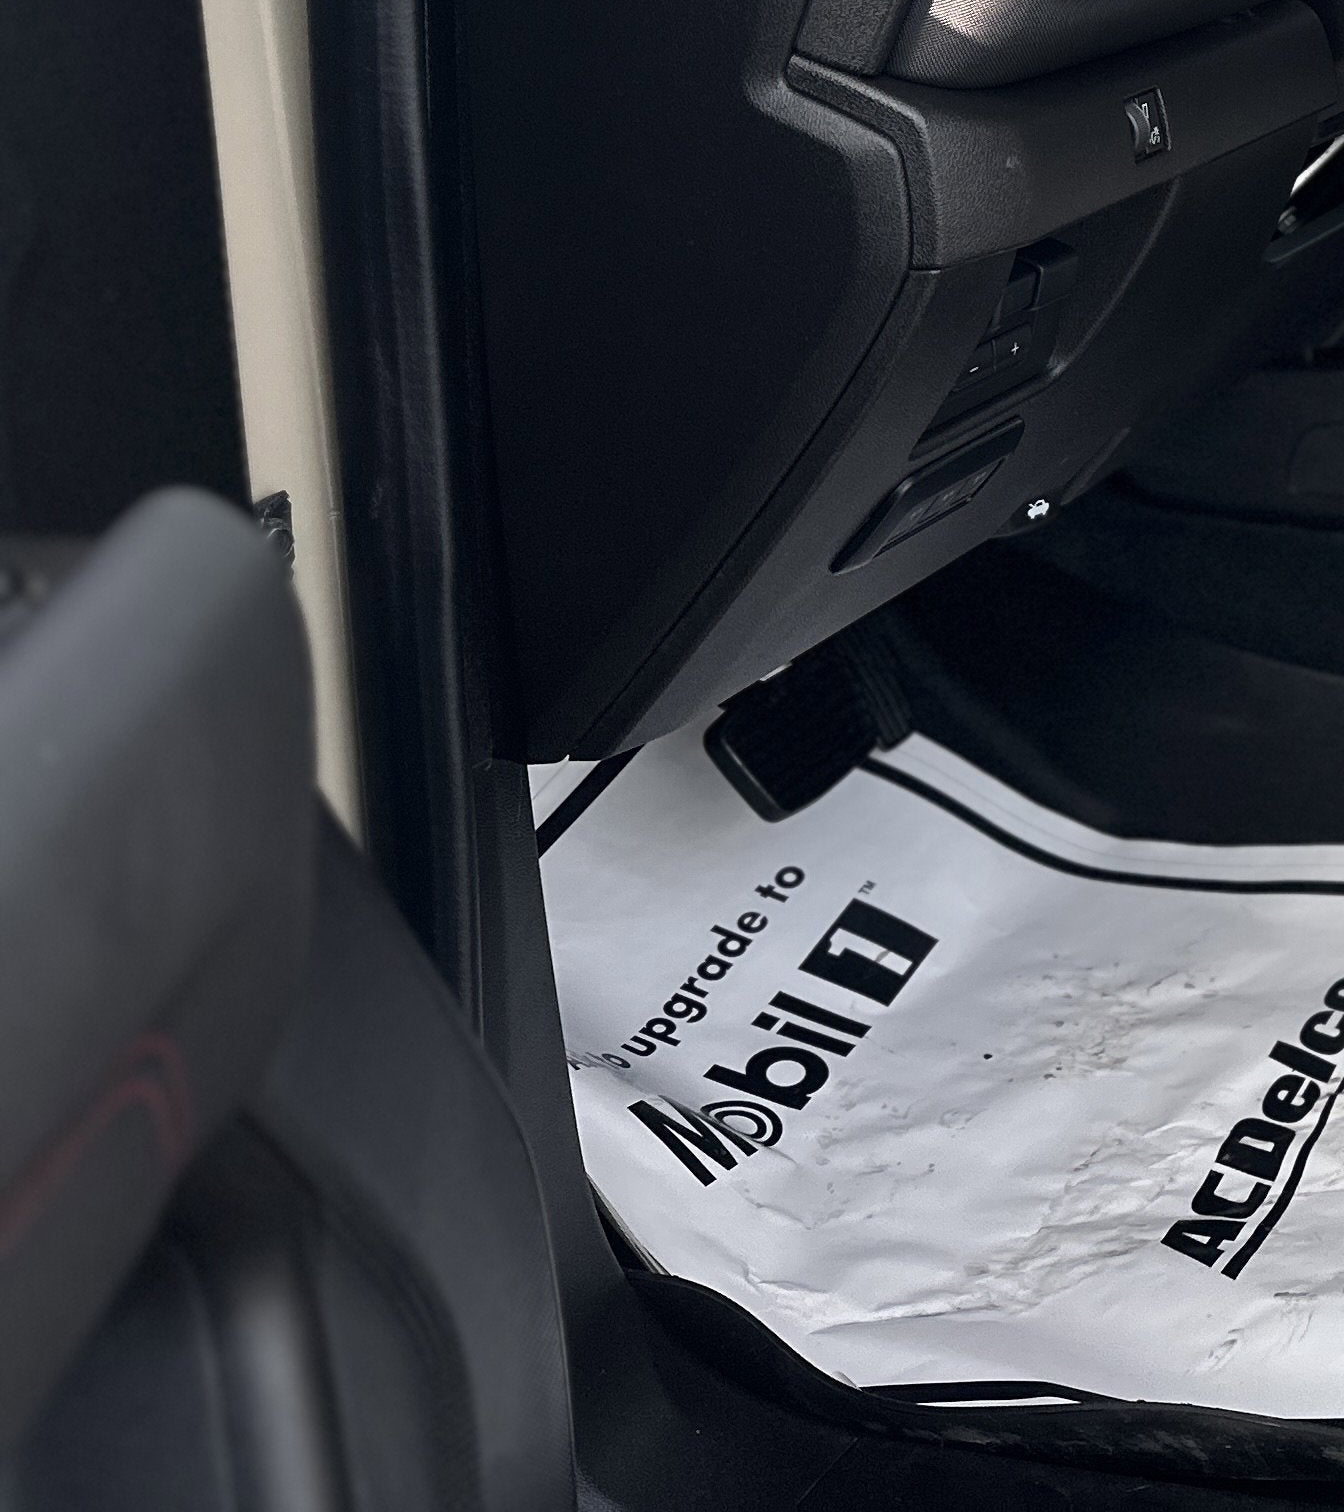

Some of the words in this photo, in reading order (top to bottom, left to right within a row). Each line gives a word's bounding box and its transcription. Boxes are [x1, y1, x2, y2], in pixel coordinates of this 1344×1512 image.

[621, 911, 768, 1057] upgrade
[754, 866, 805, 903] to
[627, 990, 872, 1187] Mobil
